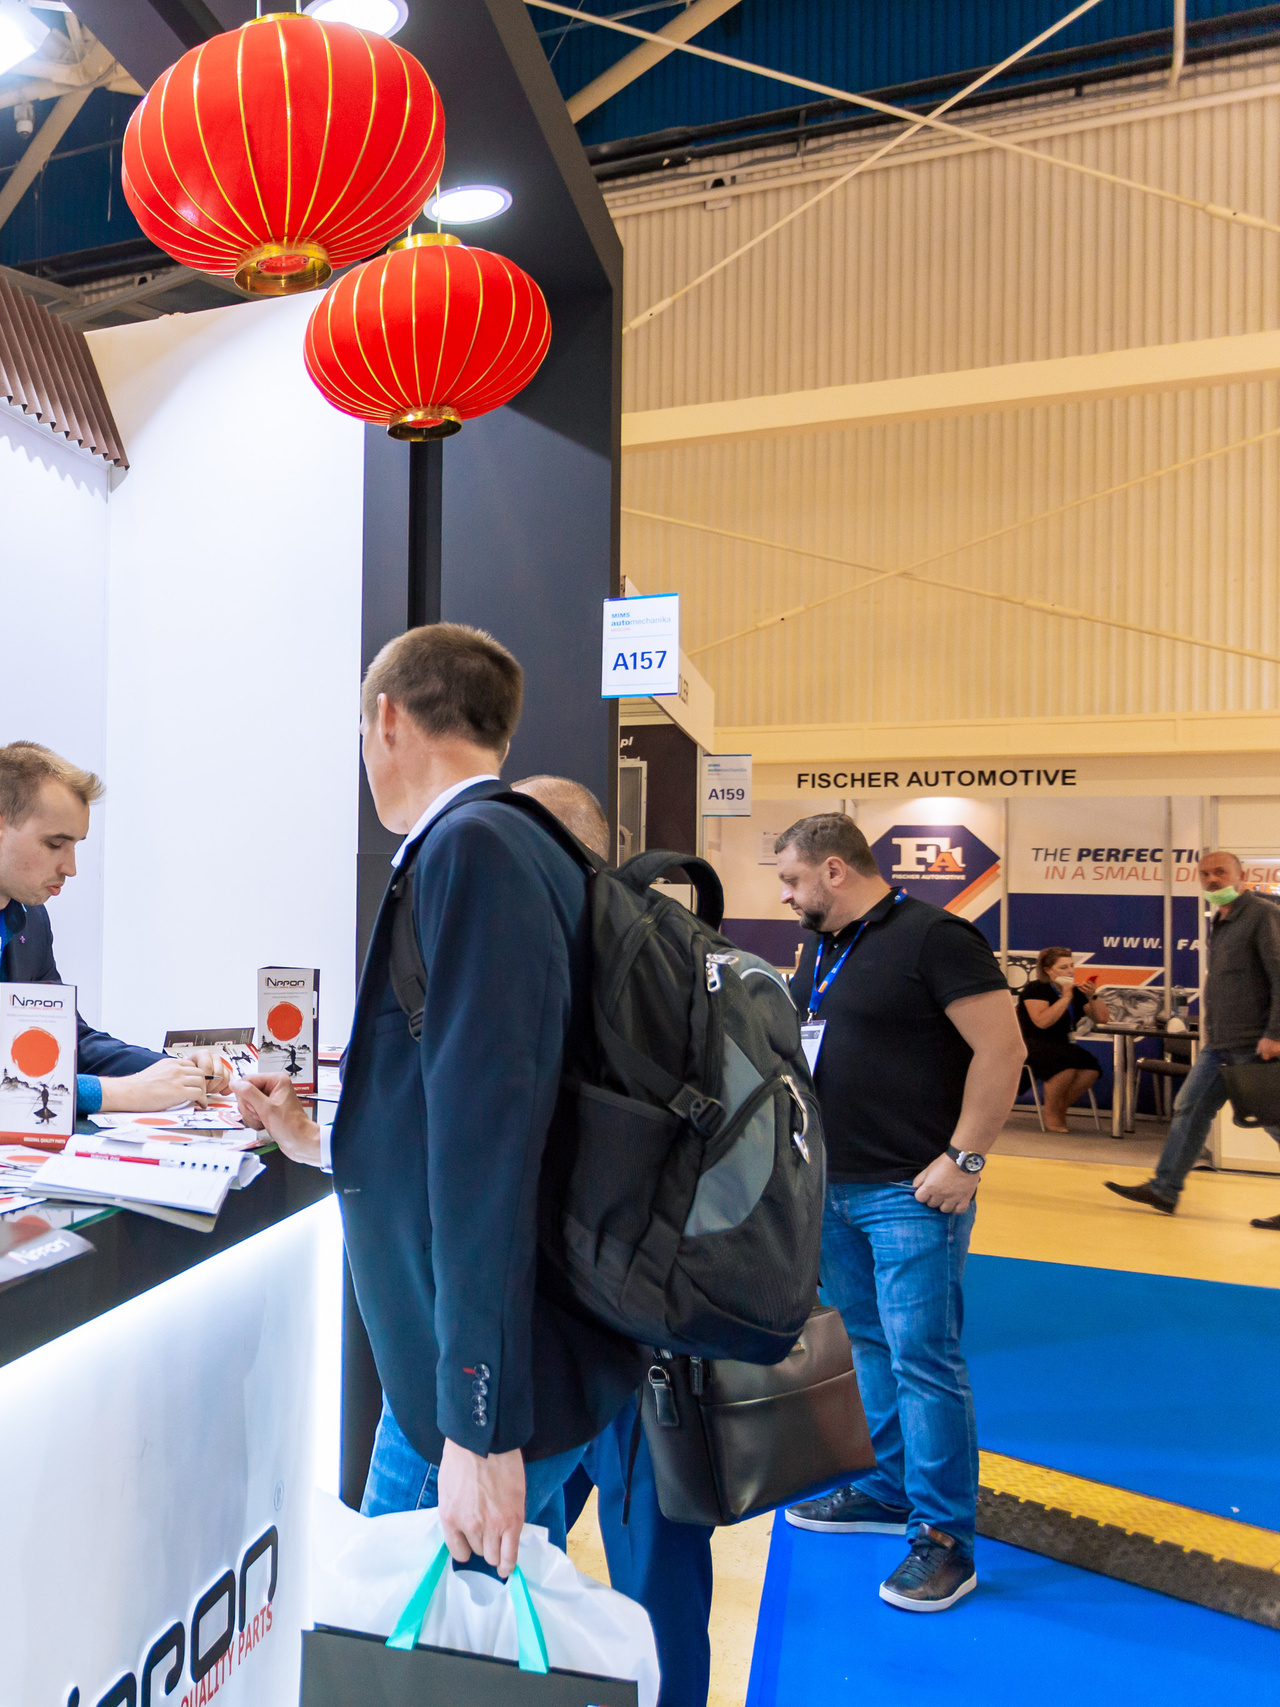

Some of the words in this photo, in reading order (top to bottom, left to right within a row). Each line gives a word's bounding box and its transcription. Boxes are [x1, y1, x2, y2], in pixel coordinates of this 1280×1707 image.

[611, 616, 672, 627] automechanika
[612, 650, 668, 671] A157
[796, 772, 900, 789] FISCHER
[906, 769, 1078, 788] AUTOMOTIVE
[708, 788, 745, 801] A159
[1032, 847, 1071, 862] THE
[1044, 865, 1067, 880] IN
[1071, 866, 1086, 880] A
[1092, 865, 1163, 881] SMALL
[237, 1600, 273, 1666] PARTS
